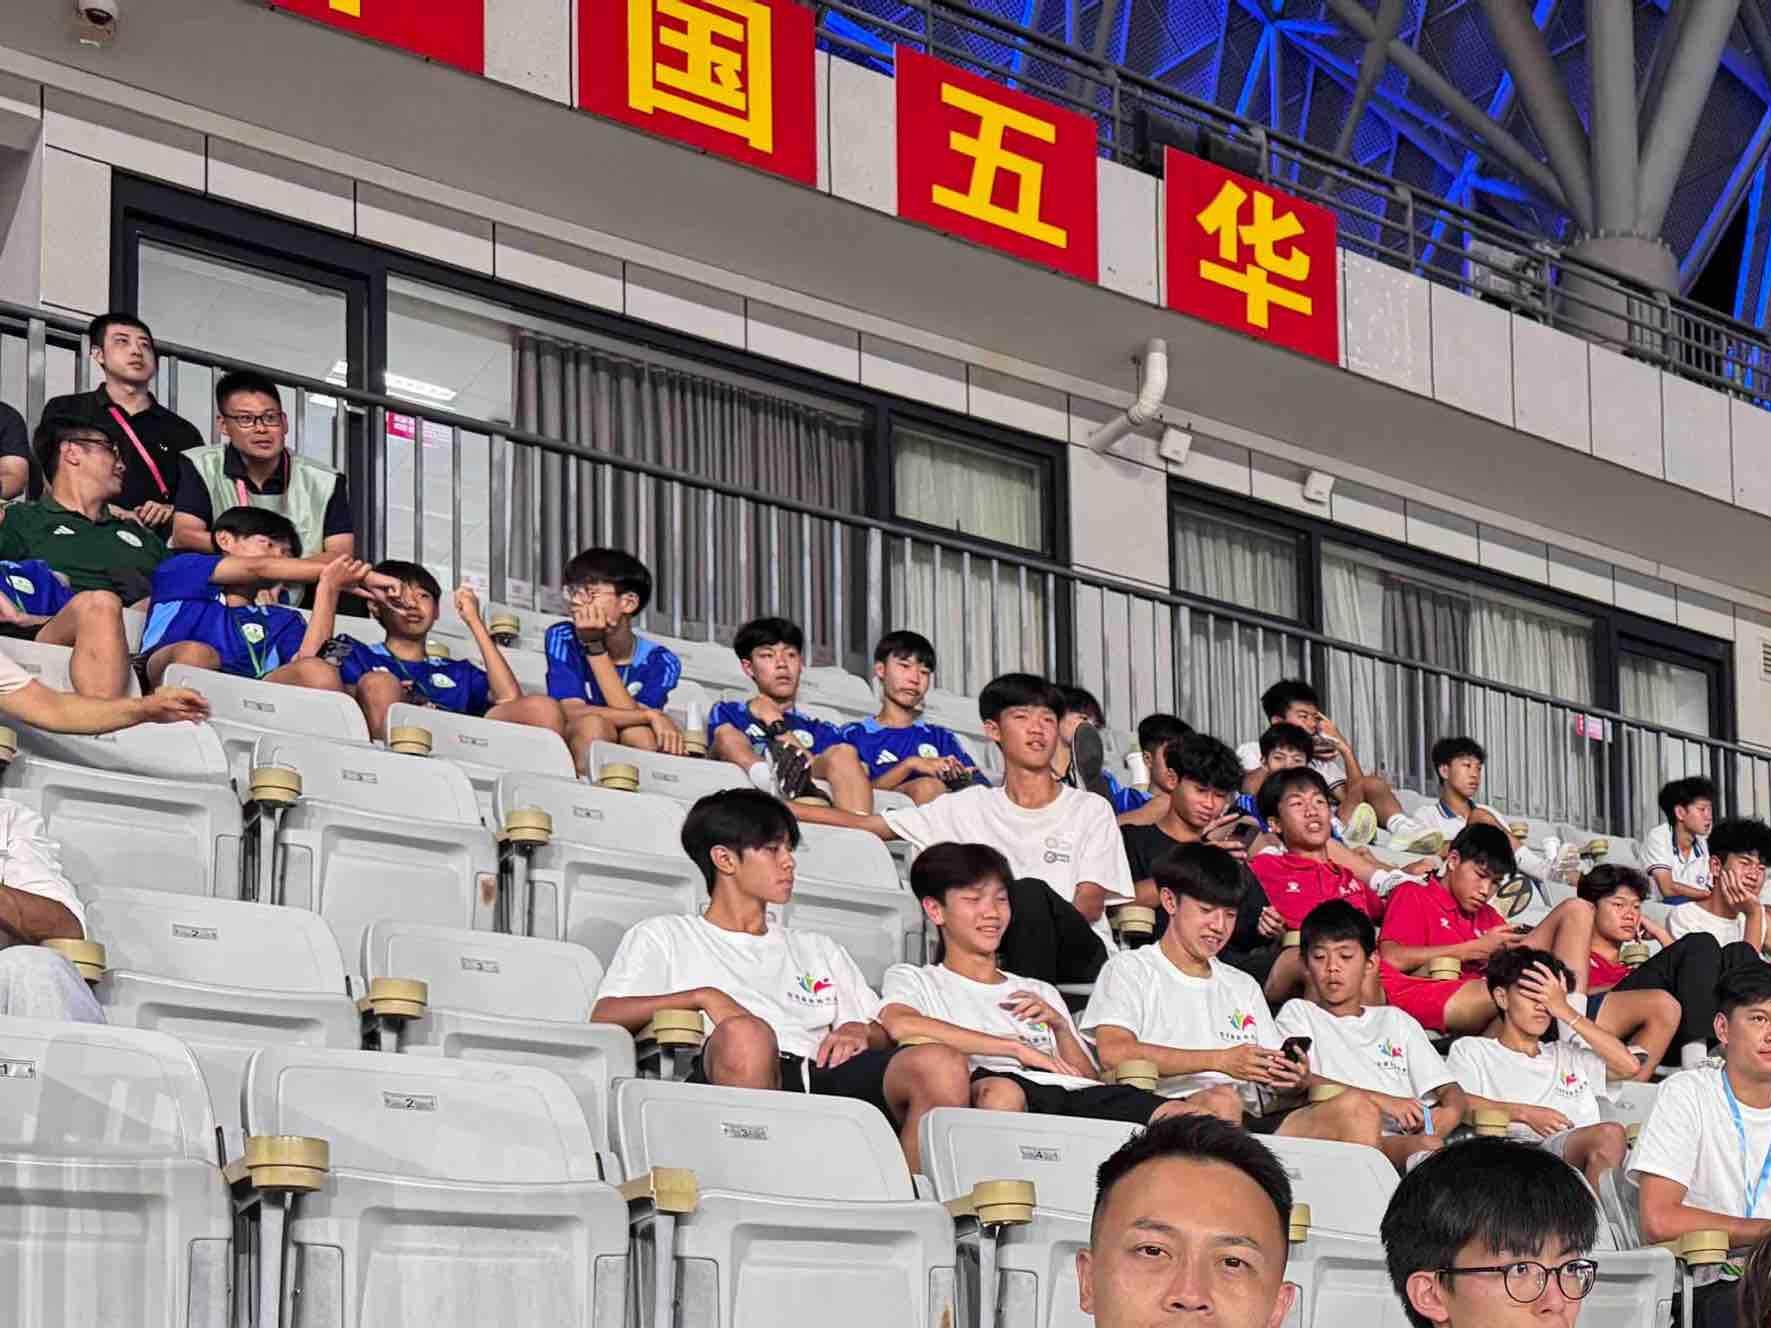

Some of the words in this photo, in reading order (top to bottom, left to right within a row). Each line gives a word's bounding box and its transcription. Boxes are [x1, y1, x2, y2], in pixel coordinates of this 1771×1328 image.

[628, 0, 773, 151] 国
[933, 85, 1067, 246] 五
[1197, 182, 1312, 329] 华
